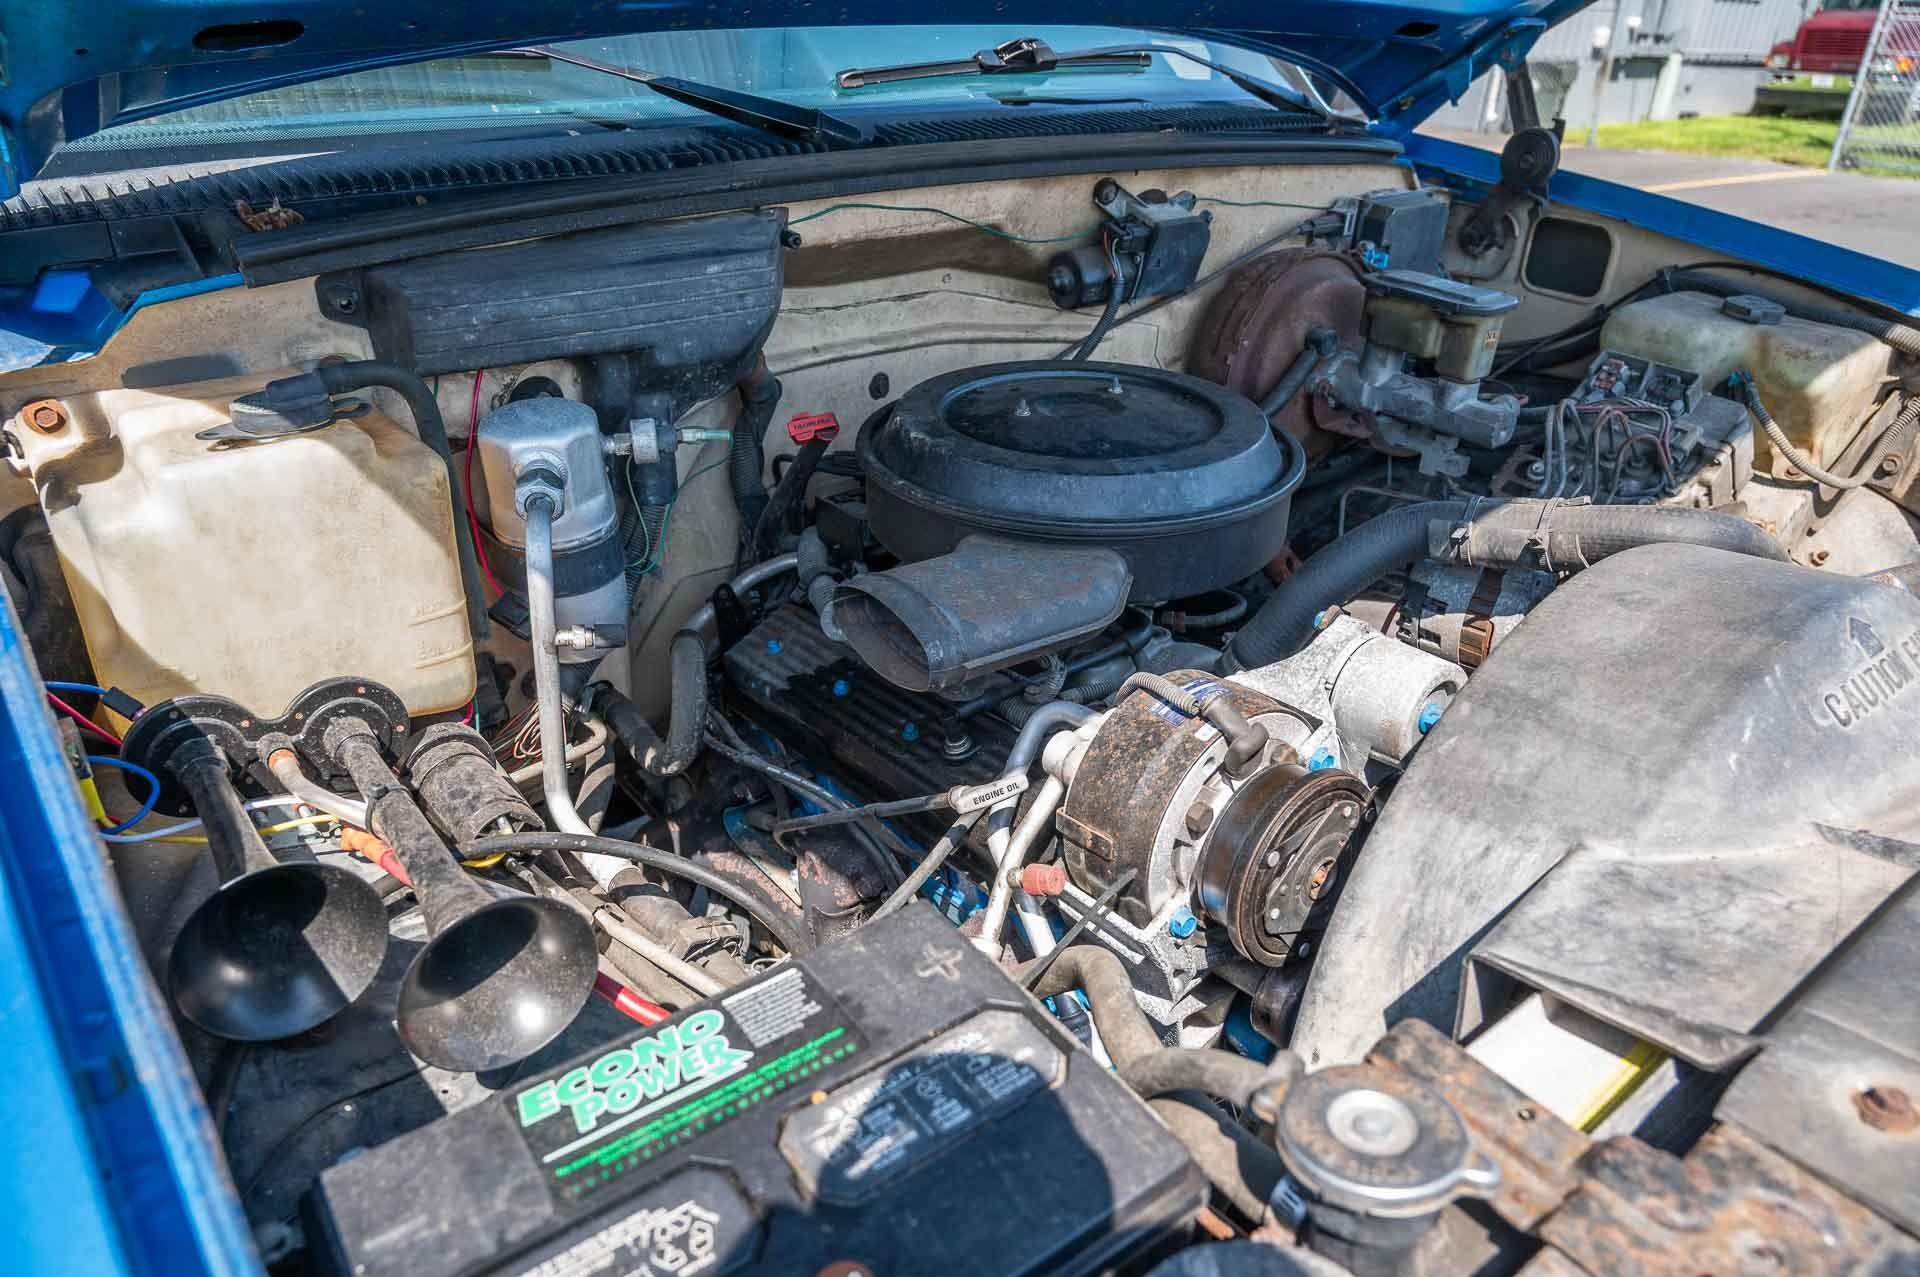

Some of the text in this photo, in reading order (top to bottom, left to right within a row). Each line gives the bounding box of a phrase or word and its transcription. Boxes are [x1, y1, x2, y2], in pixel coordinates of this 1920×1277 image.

[1823, 649, 1915, 728] CAUTION
[973, 782, 1020, 806] ENGINE OIL
[516, 1008, 725, 1128] ECONO
[570, 1034, 754, 1134] POWER
